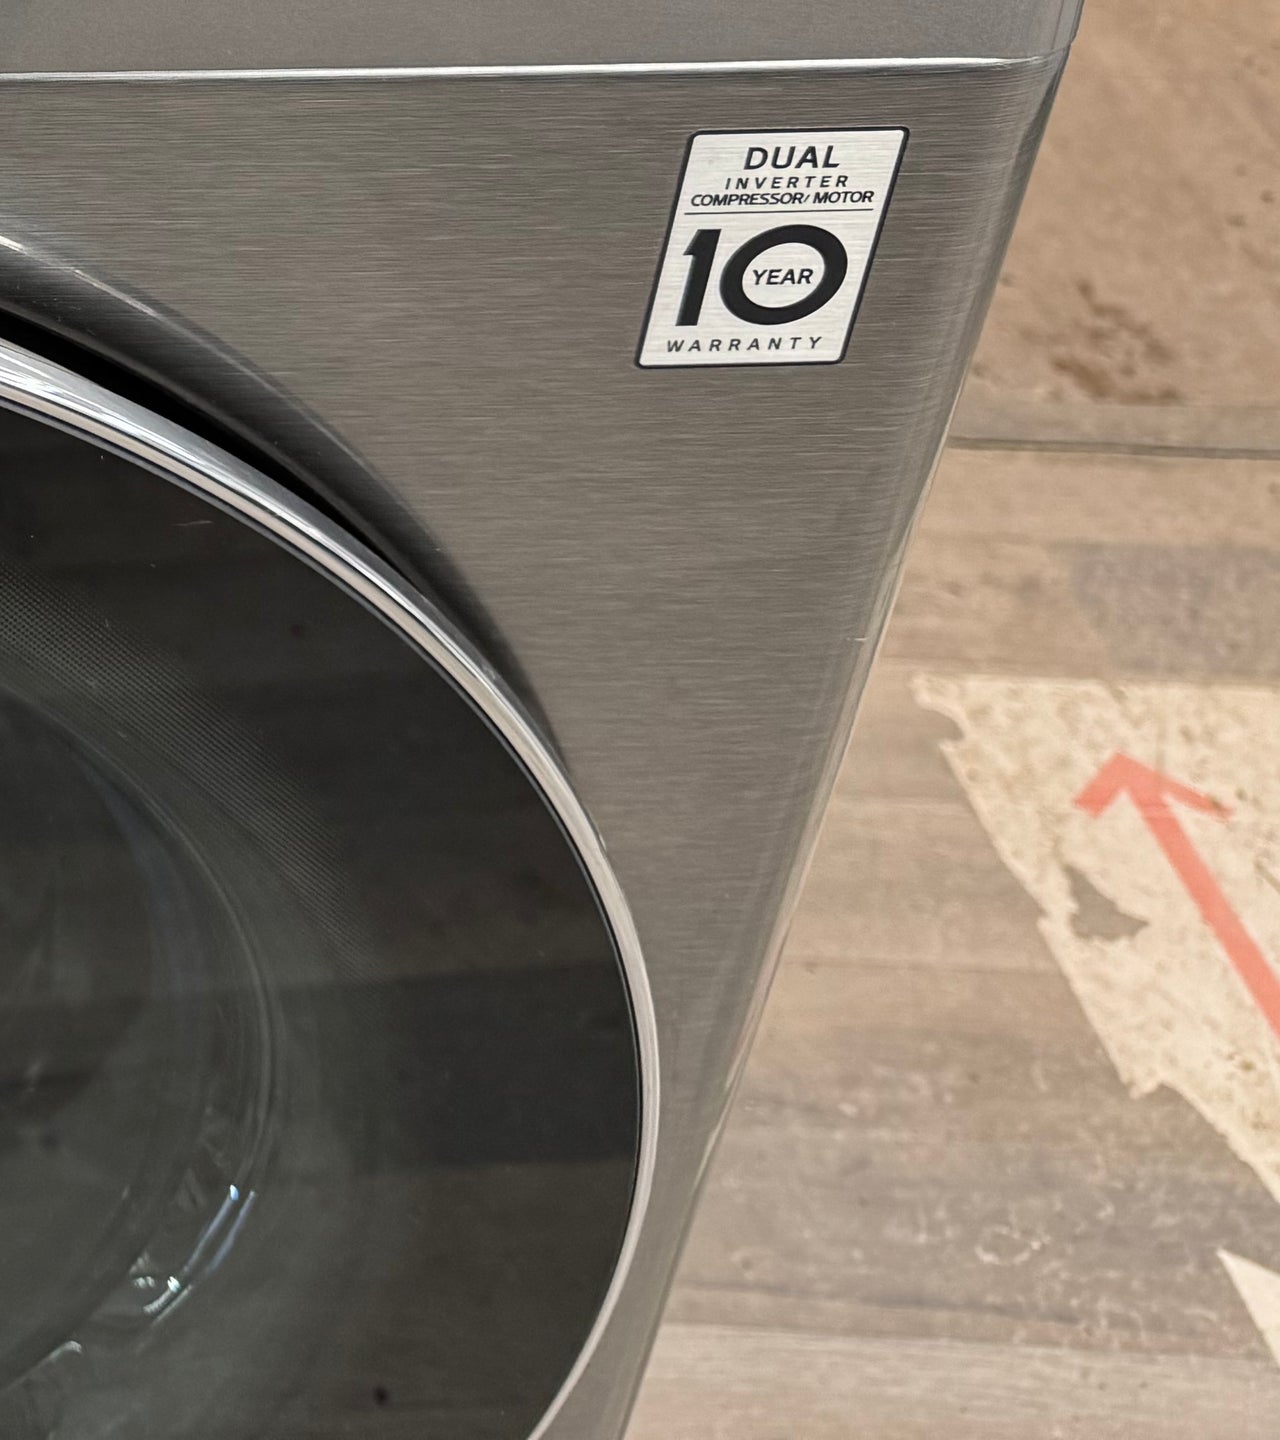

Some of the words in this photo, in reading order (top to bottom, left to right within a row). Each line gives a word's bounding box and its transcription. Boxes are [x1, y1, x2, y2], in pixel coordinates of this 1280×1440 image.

[744, 145, 840, 170] DUAL
[725, 175, 849, 190] INVERTER
[813, 191, 874, 204] MOTOR
[675, 224, 848, 326] 10
[752, 269, 814, 285] YEAR
[667, 336, 822, 352] WARRANTY
